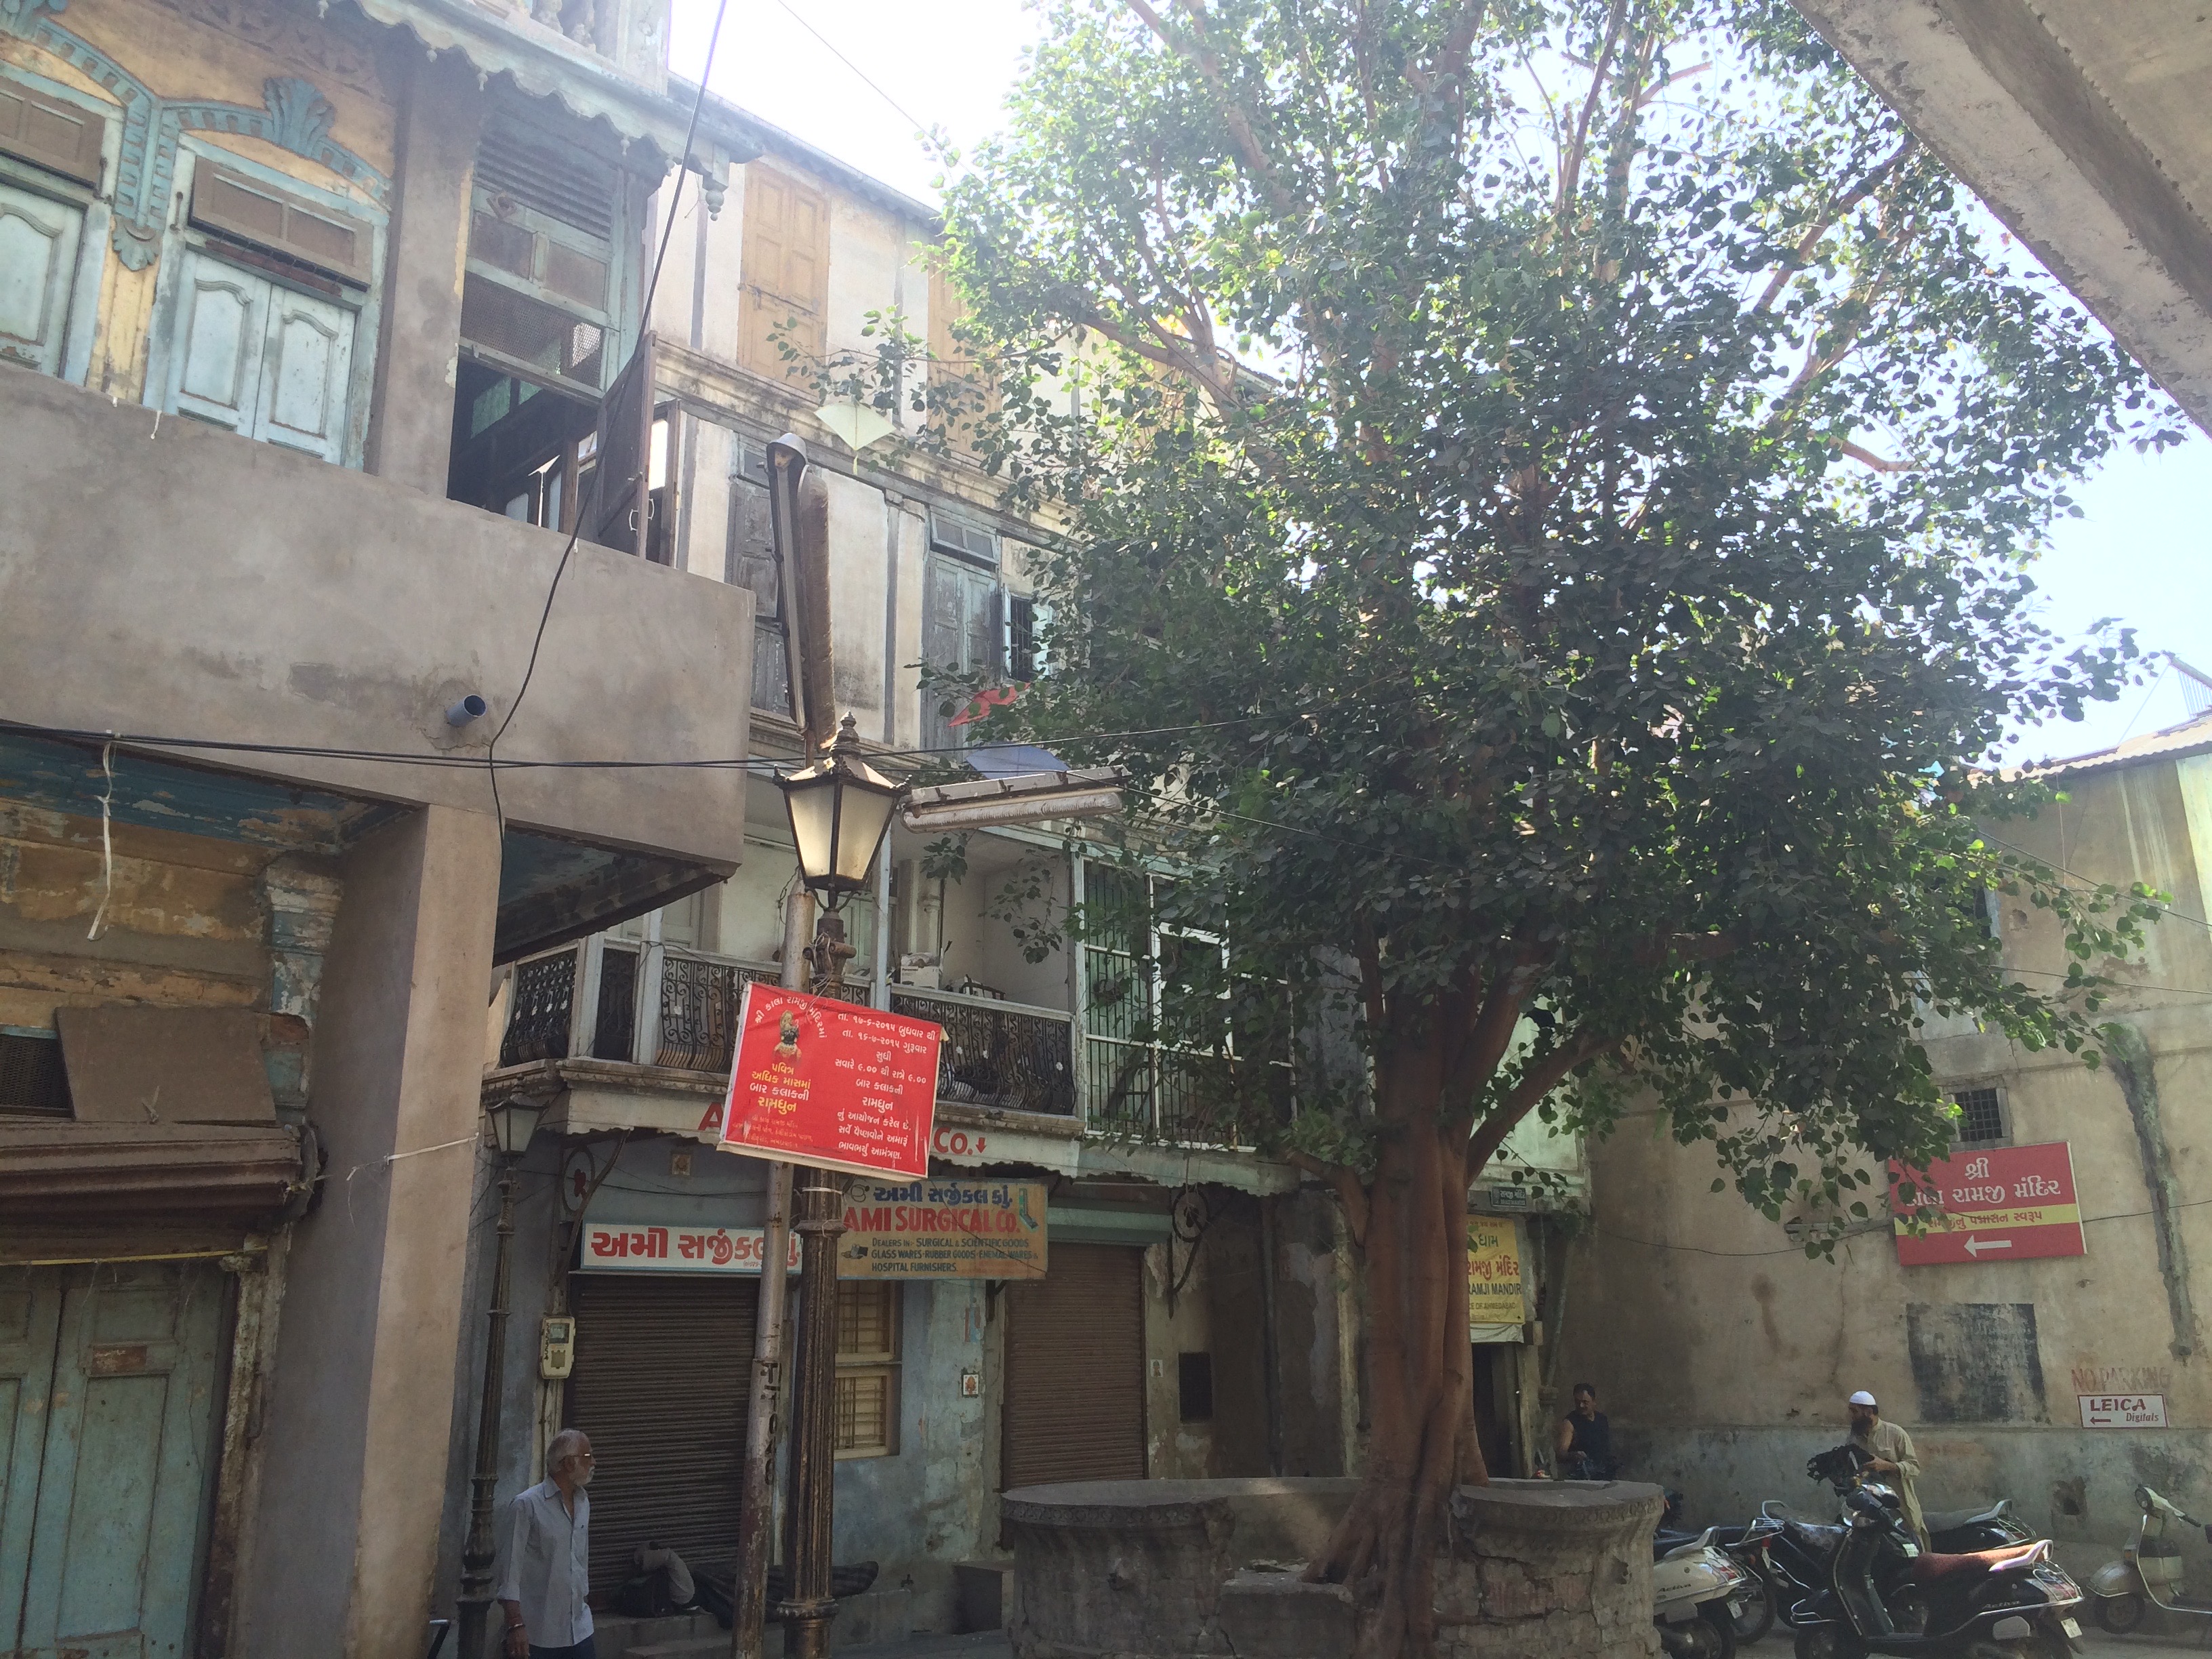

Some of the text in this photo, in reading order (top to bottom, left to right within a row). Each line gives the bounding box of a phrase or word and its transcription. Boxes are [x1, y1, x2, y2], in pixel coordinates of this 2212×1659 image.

[755, 1010, 764, 1023] શ્રી
[765, 997, 783, 1011] કાલા
[787, 996, 807, 1010] રામજી
[838, 1012, 848, 1021] તા.
[899, 1025, 924, 1038] બુધવાર
[926, 1030, 936, 1040] થી
[842, 1029, 853, 1038] તા.
[876, 1051, 892, 1063] સુધી
[772, 1062, 794, 1076] પવિત્ર
[835, 1058, 855, 1069] સવારે
[880, 1065, 889, 1076] થી
[893, 1068, 905, 1080] રાત્રે
[752, 1070, 811, 1090] અધિક માસમાં
[856, 1078, 903, 1094] બાર કલાકની
[750, 1082, 810, 1101] બાર કલાકની
[758, 1097, 797, 1115] રામધુન
[862, 1097, 893, 1113] રામધુન
[837, 1108, 845, 1121] નું
[848, 1111, 880, 1125] આયોજન
[883, 1116, 900, 1128] કરેલ
[1965, 1157, 1990, 1181] શ્રી
[874, 1182, 922, 1202] અમી
[928, 1183, 988, 1206] સર્જીકલ
[1952, 1185, 2006, 1204] રામજી
[2013, 1174, 2061, 1198] મંદિર
[844, 1207, 891, 1231] AMI
[895, 1206, 993, 1232] SURGICAL
[2013, 1211, 2042, 1223] સ્વરૂપ
[590, 1227, 669, 1258] અમી
[916, 1237, 954, 1247] SURGICAL
[961, 1238, 1002, 1247] SCIENTIFIC
[1002, 1239, 1029, 1247] GOODS
[1479, 1233, 1498, 1247] ધામ
[872, 1250, 897, 1258] GLASS
[872, 1263, 908, 1272] HOSPITAL
[1496, 1254, 1519, 1275] મંદિર
[1492, 1283, 1522, 1295] MANDIR
[2071, 1368, 2097, 1392] NO
[2090, 1399, 2146, 1412] LEICA
[2125, 1412, 2159, 1422] Digitals
